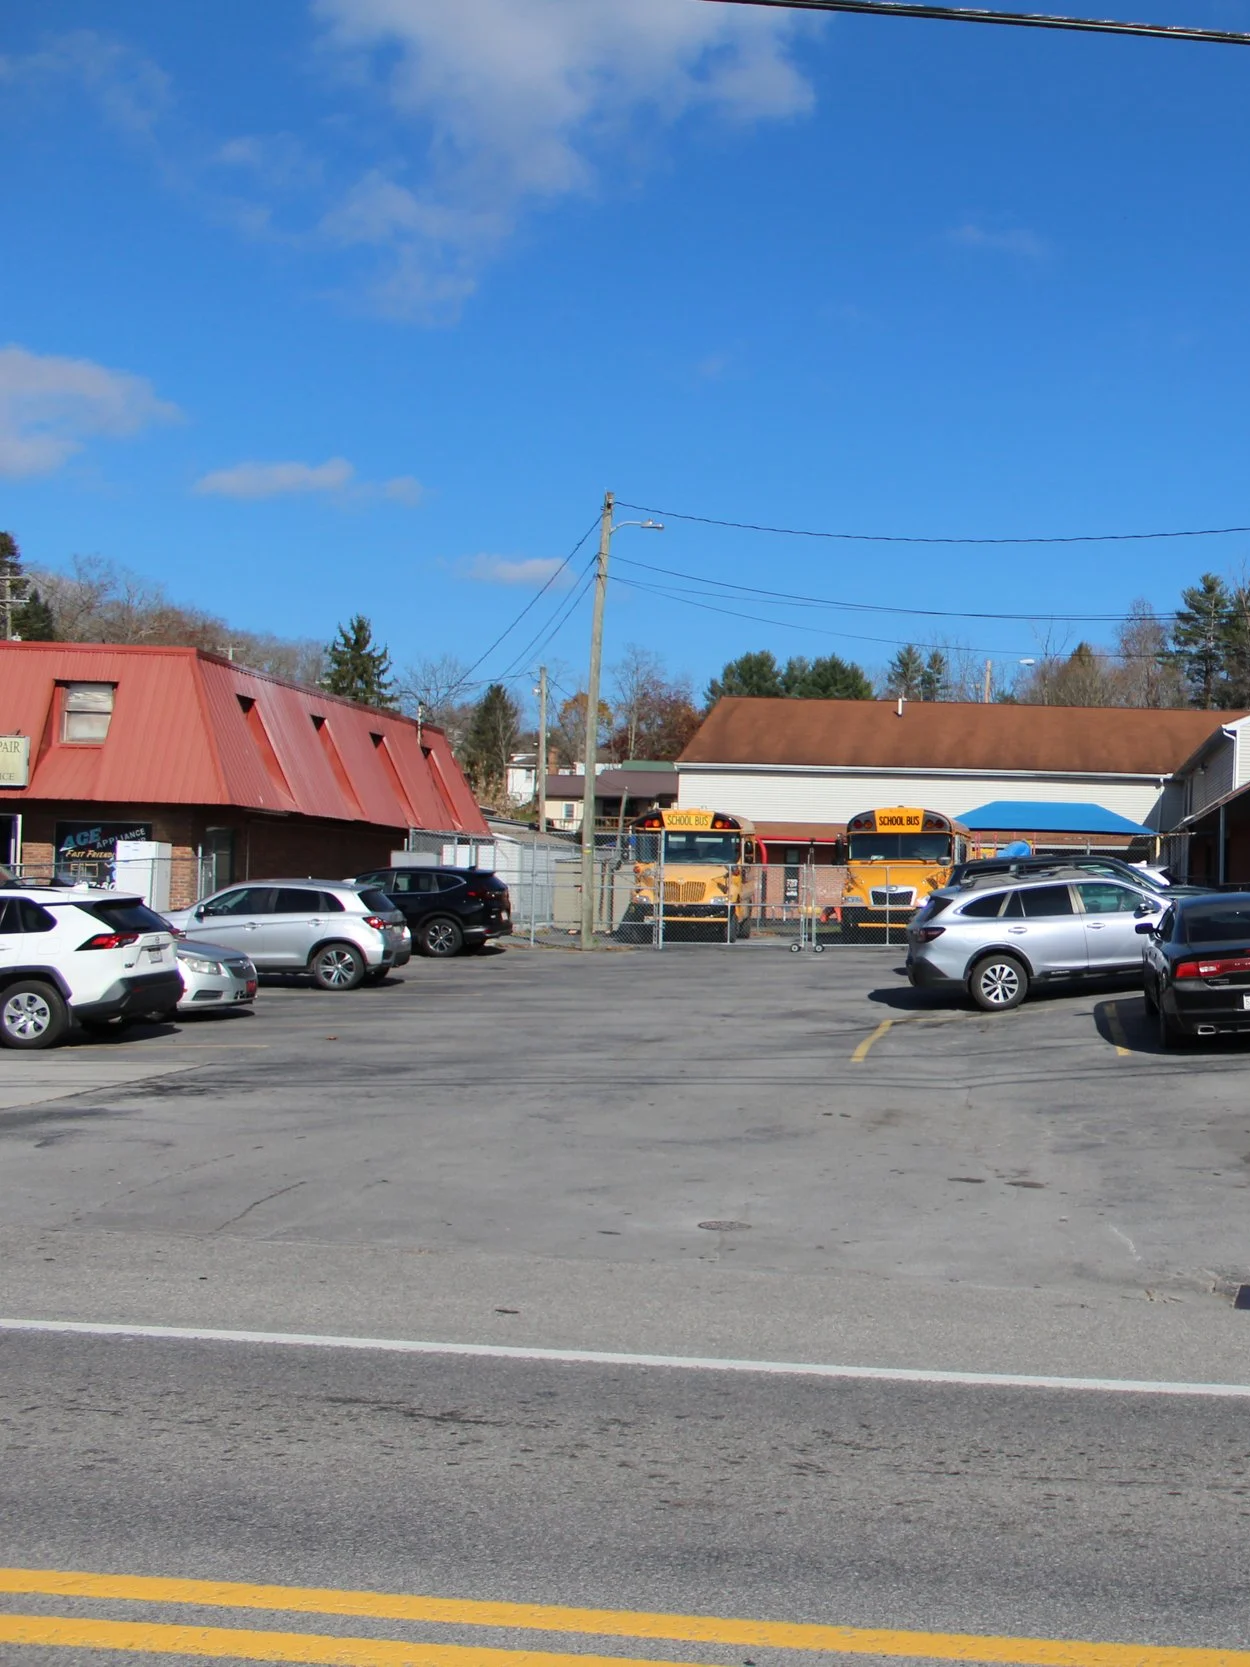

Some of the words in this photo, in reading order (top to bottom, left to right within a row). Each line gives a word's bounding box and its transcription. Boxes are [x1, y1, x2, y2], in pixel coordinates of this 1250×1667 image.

[667, 815, 693, 826] SCHOOL
[694, 816, 709, 826] BUS
[879, 816, 905, 826] SCHOOL
[906, 816, 920, 826] BUS
[63, 827, 102, 847] ACE
